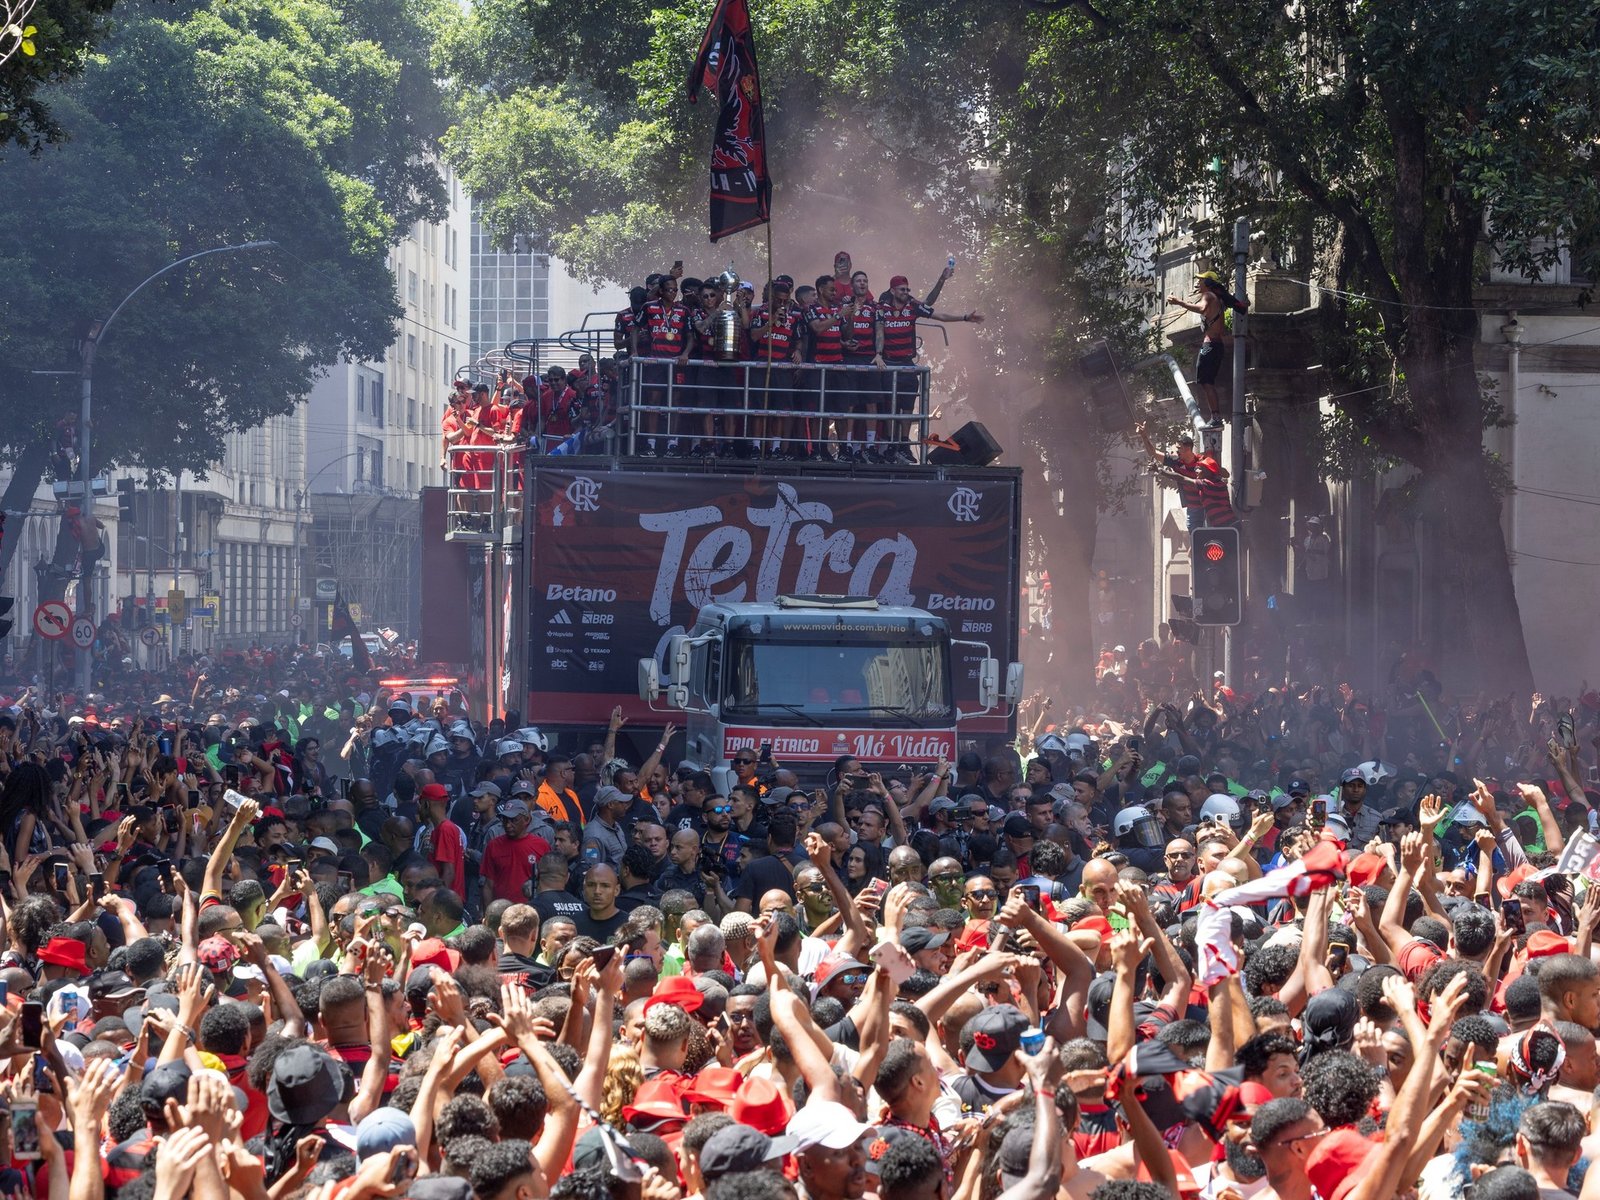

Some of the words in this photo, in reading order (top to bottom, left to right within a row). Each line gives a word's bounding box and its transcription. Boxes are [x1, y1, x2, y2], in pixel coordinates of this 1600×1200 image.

[639, 482, 918, 626] Tetra
[546, 584, 617, 602] Betano
[927, 593, 996, 611] Betano
[592, 614, 614, 625] BRB
[971, 622, 993, 633] BRB
[75, 625, 92, 638] 60
[853, 734, 886, 758] Mó
[890, 735, 951, 758] Vidão
[678, 817, 692, 831] 45
